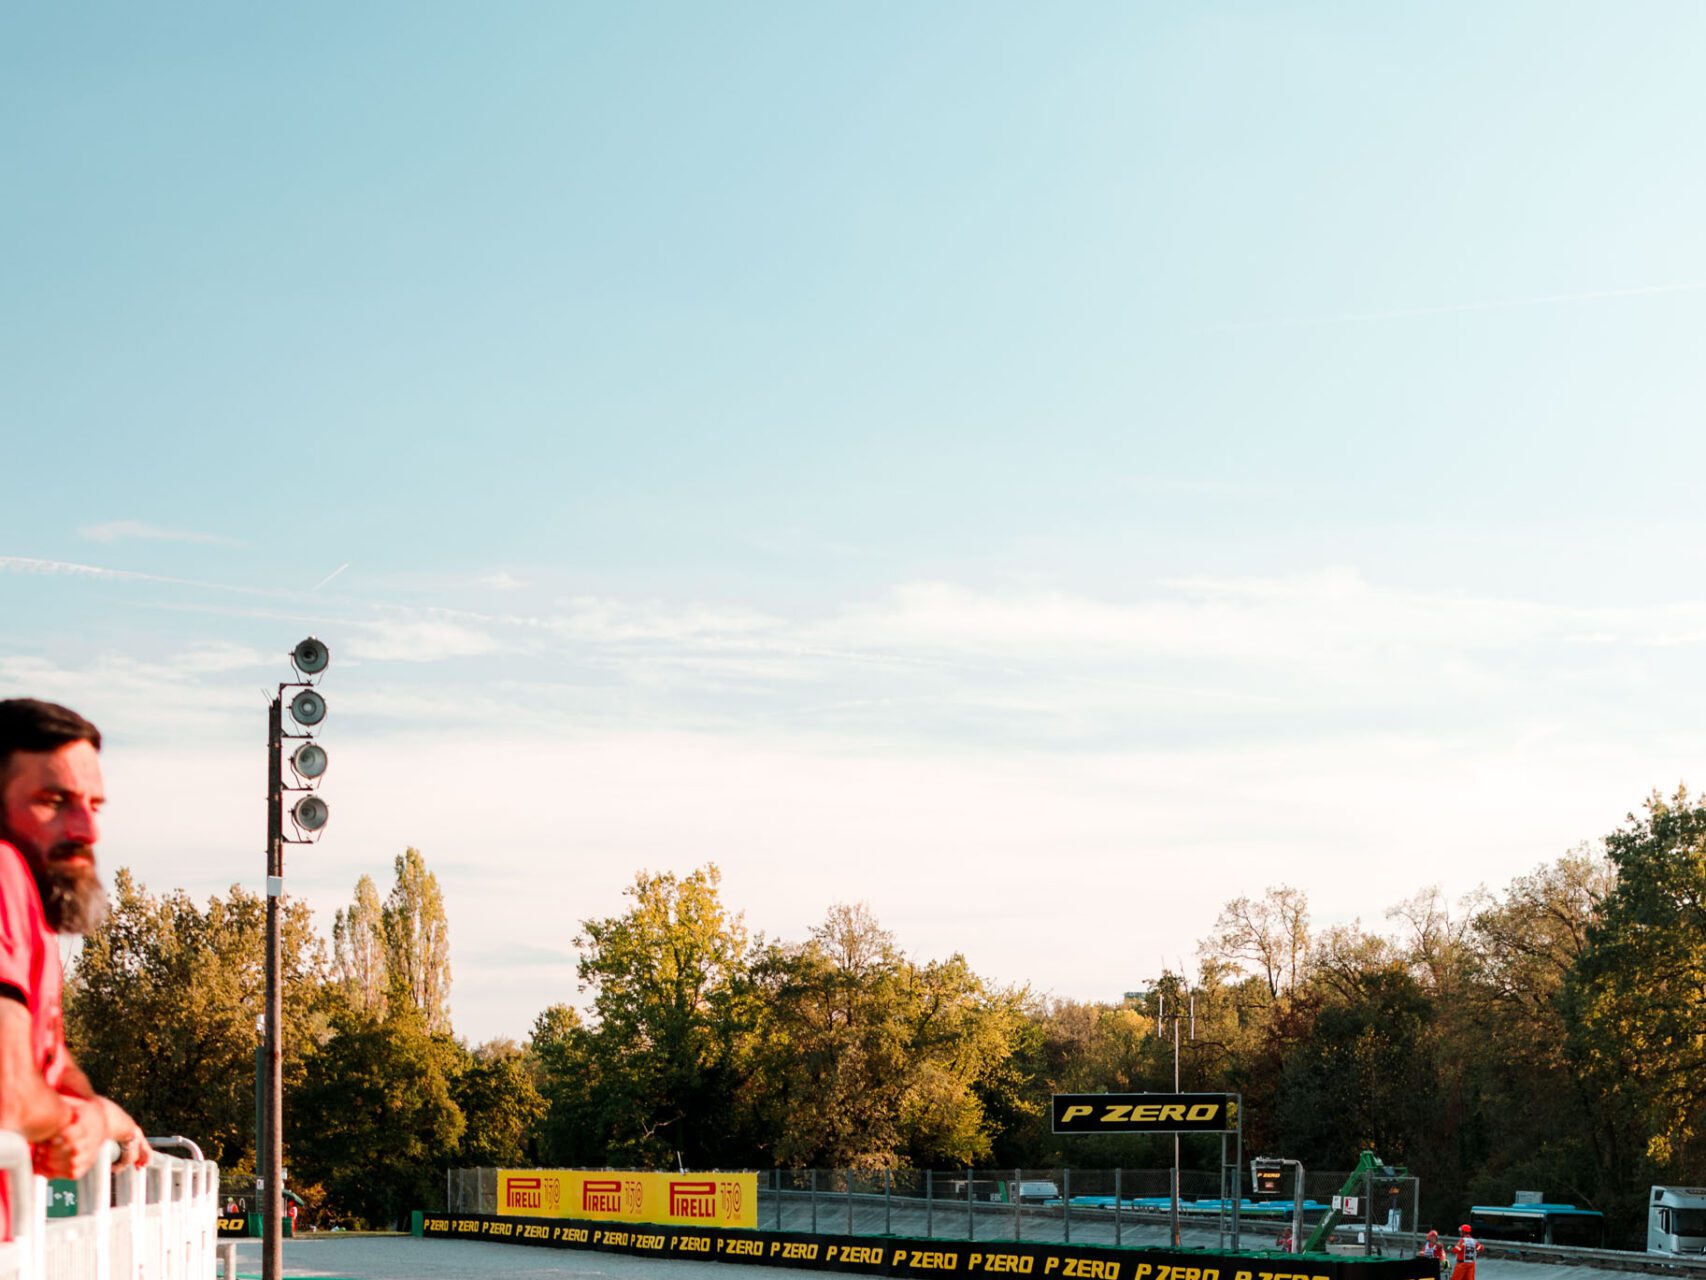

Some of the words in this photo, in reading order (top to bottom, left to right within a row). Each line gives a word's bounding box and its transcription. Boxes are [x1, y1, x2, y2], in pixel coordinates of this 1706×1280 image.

[1061, 1105, 1094, 1123] P
[1100, 1104, 1219, 1122] ZERO
[507, 1178, 541, 1208] PIRELLI
[583, 1180, 621, 1212] PIRELLI
[669, 1182, 716, 1217] PIRELLI
[217, 1218, 245, 1231] RO
[423, 1219, 430, 1229] P
[431, 1220, 449, 1231] ZERO
[452, 1220, 458, 1230] P
[458, 1221, 479, 1232] ZERO
[482, 1221, 489, 1232] P
[490, 1223, 512, 1235] ZERO
[515, 1224, 523, 1236] P
[524, 1226, 549, 1239] ZERO
[553, 1227, 561, 1240] P
[562, 1229, 588, 1242] ZERO
[593, 1229, 602, 1243] P
[603, 1231, 628, 1245] ZERO
[630, 1232, 636, 1247] P
[636, 1234, 665, 1249] ZERO
[670, 1235, 678, 1248] P
[679, 1236, 710, 1252] ZERO
[716, 1237, 725, 1252] P
[726, 1239, 763, 1256] ZERO
[770, 1240, 781, 1257] P
[782, 1242, 818, 1259] ZERO
[826, 1245, 838, 1260] P
[840, 1246, 883, 1264] ZERO
[893, 1249, 907, 1265] P
[909, 1251, 957, 1269] ZERO
[968, 1253, 984, 1270] P
[985, 1253, 1033, 1274] ZERO
[1044, 1256, 1061, 1275] P
[1062, 1258, 1121, 1280] ZERO
[1134, 1263, 1153, 1280] P
